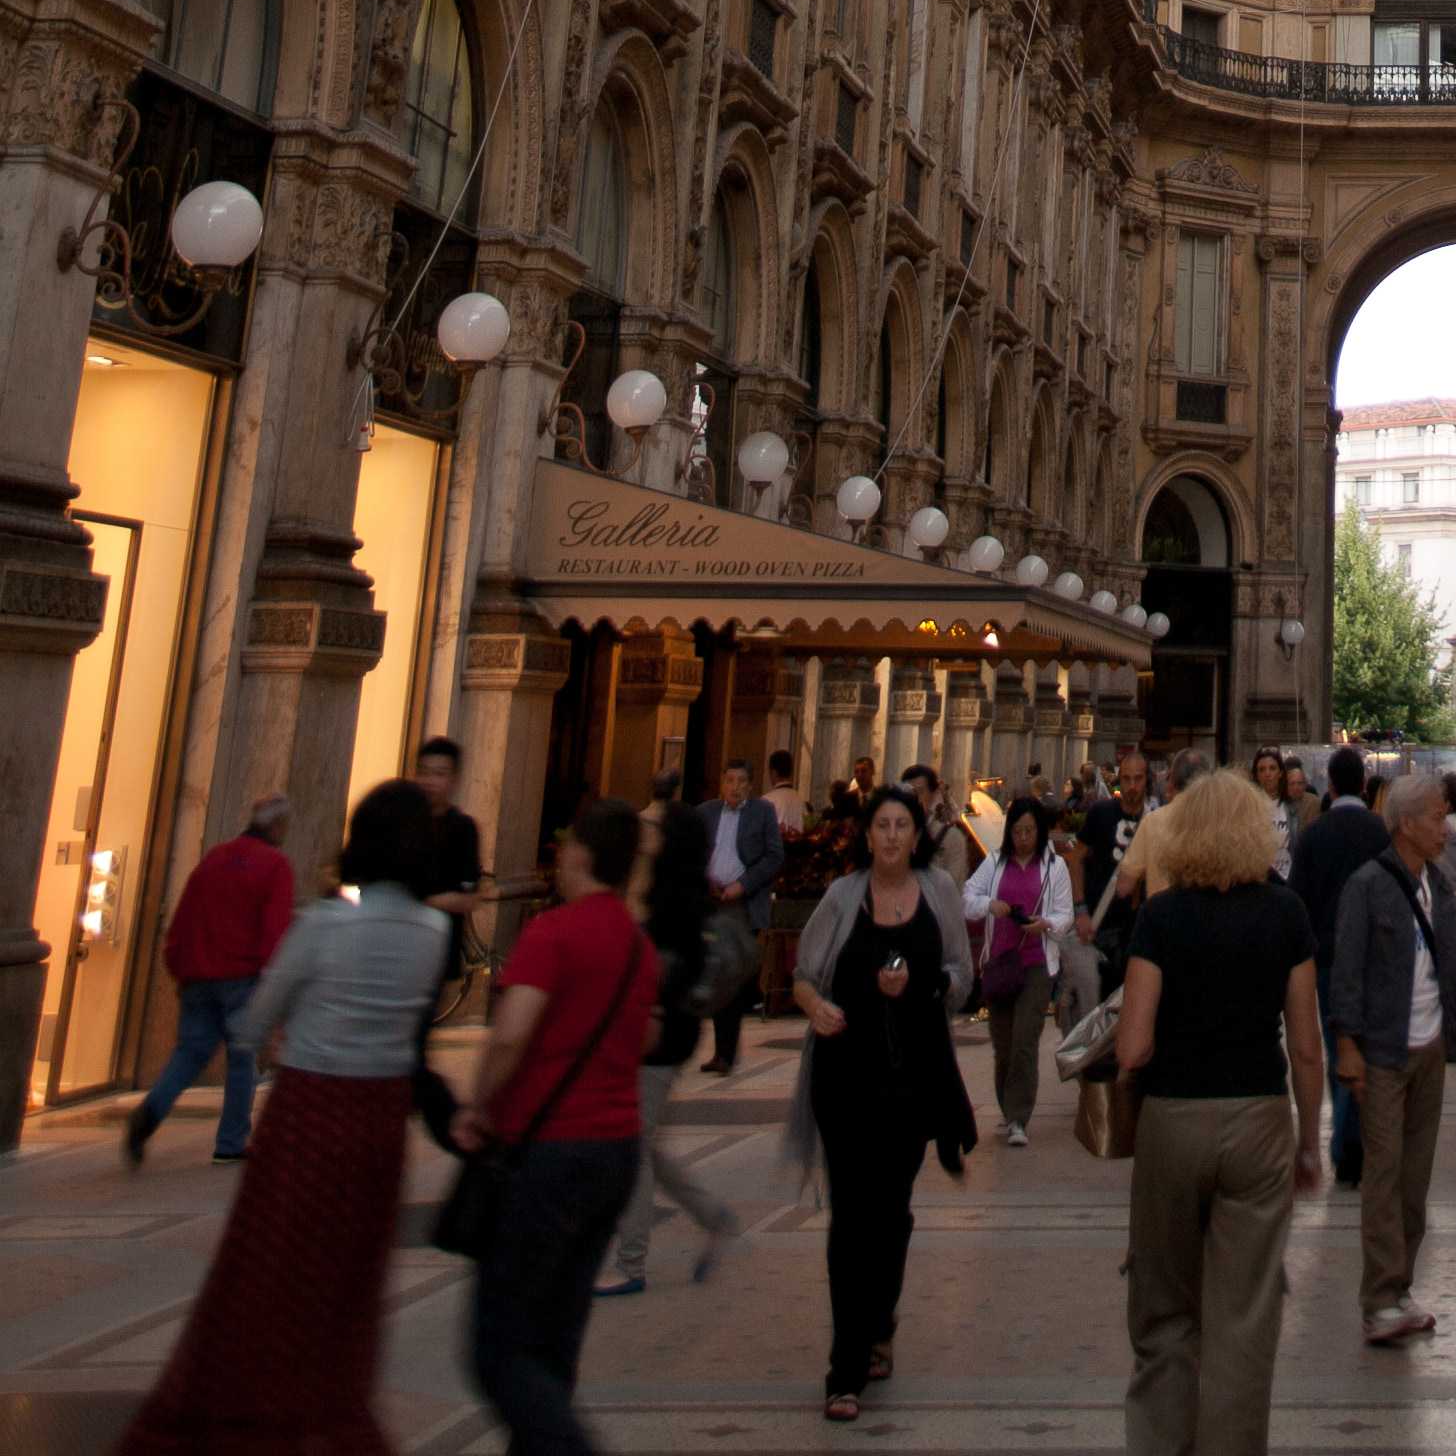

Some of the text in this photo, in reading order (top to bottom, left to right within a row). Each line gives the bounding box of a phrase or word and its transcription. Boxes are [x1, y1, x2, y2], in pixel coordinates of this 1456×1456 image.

[559, 500, 720, 549] Galleria
[557, 558, 680, 575] RESTAURANT
[694, 559, 750, 576] WOOD
[754, 560, 808, 576] OVEN
[812, 561, 865, 577] PIZZA
